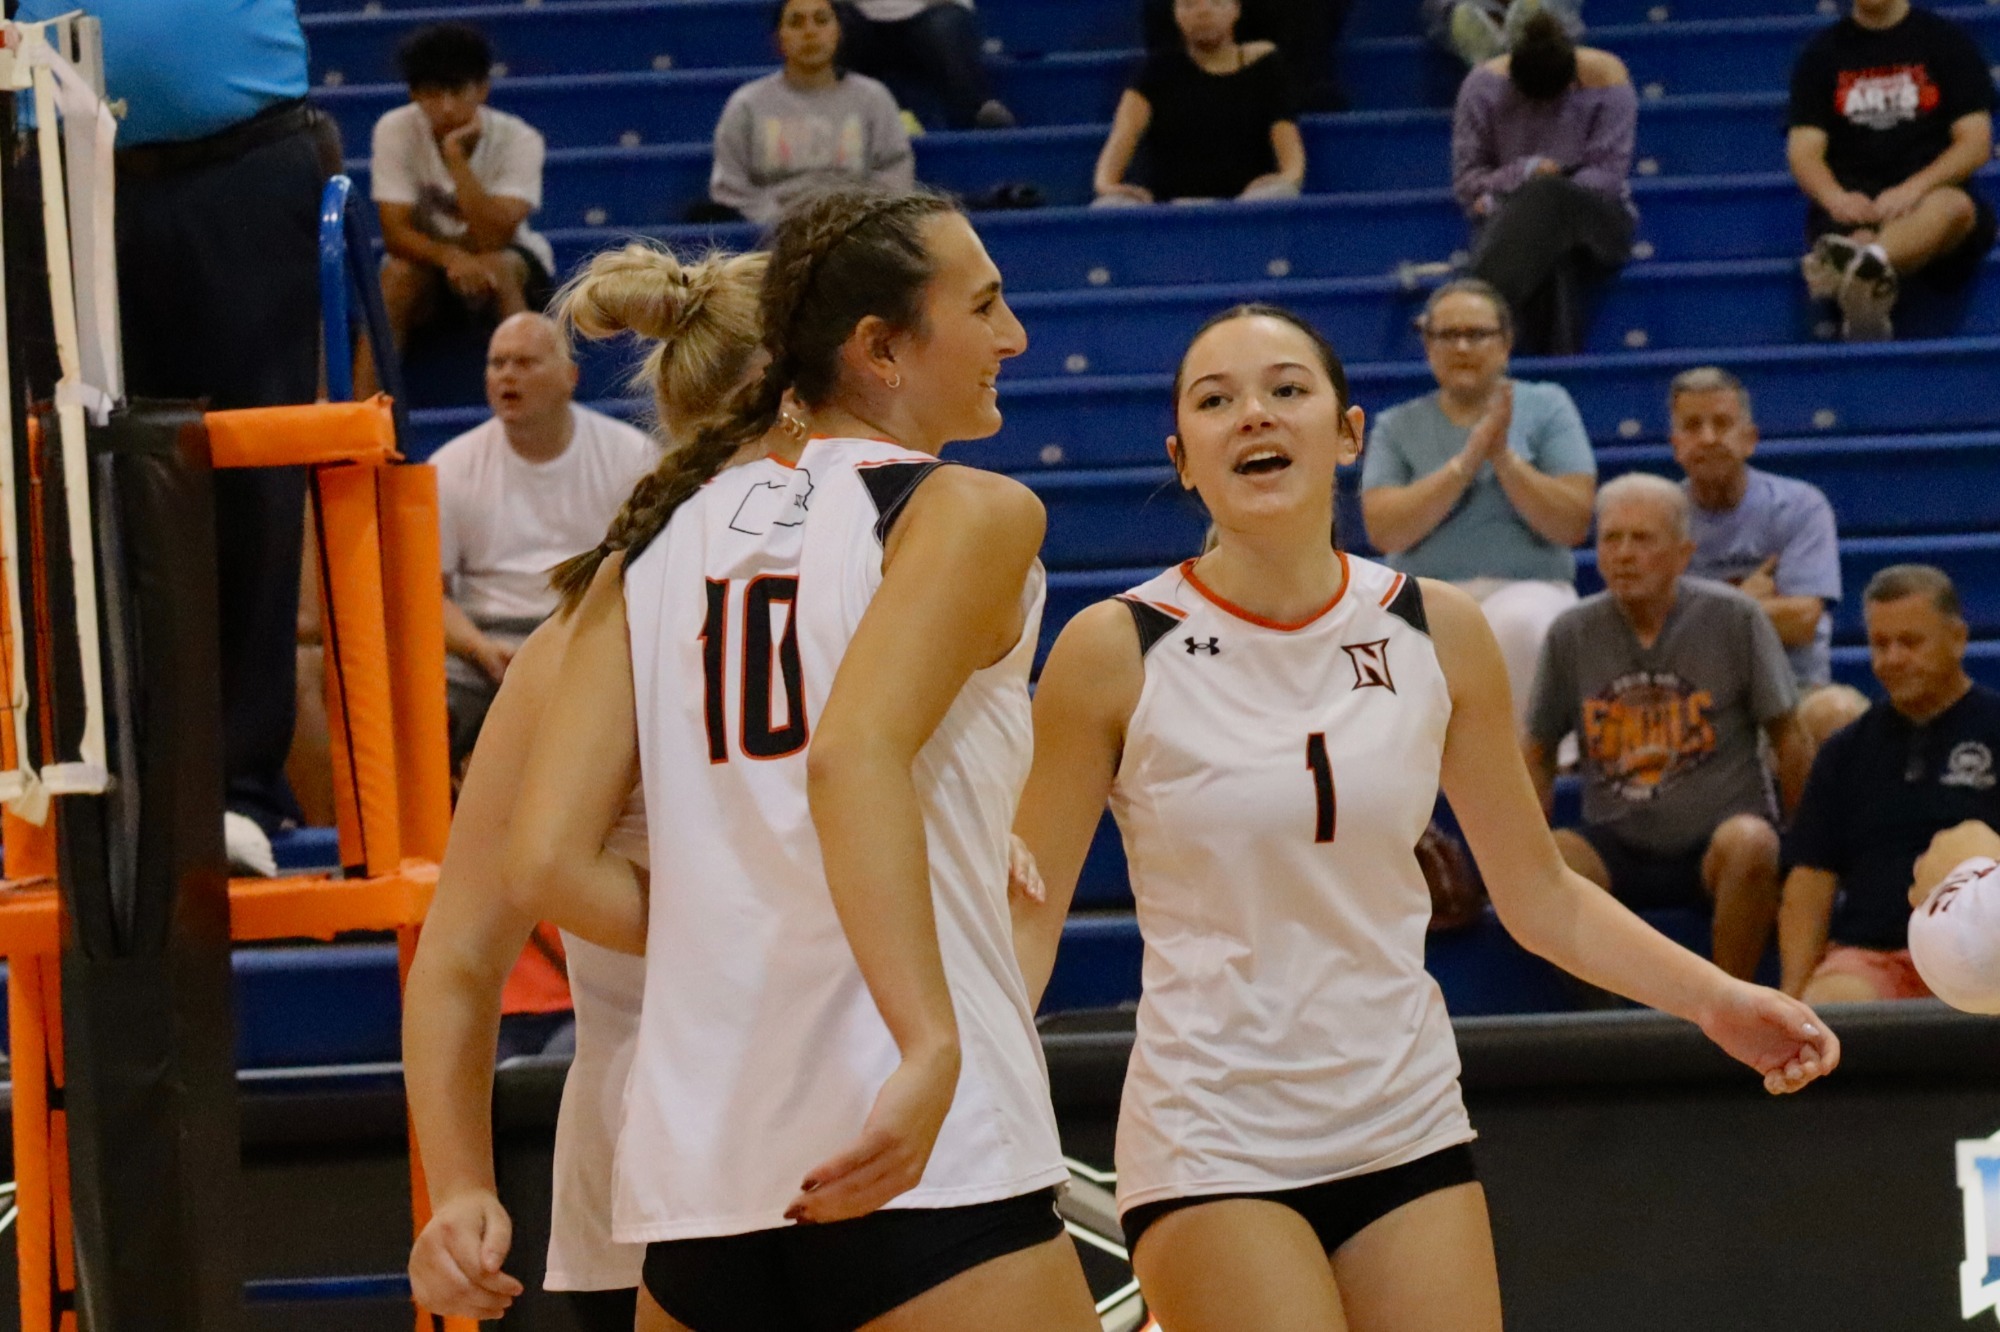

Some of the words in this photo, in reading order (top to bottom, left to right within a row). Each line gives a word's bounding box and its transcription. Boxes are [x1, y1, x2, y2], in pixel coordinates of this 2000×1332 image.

[697, 573, 809, 765] 10
[1340, 637, 1397, 696] N
[1306, 731, 1337, 843] 1
